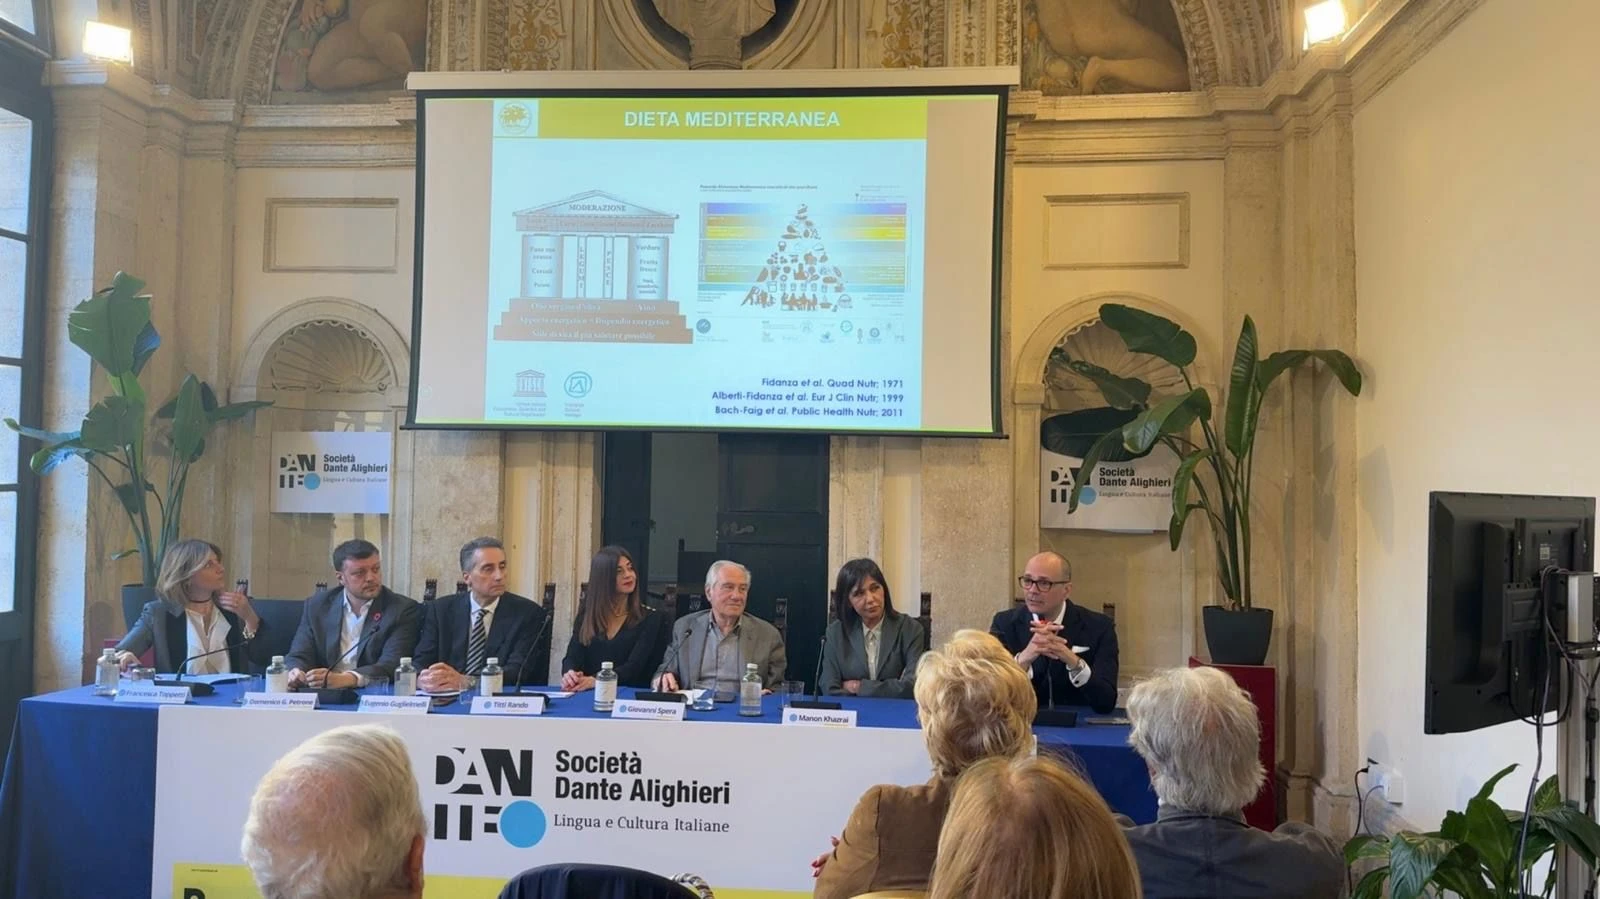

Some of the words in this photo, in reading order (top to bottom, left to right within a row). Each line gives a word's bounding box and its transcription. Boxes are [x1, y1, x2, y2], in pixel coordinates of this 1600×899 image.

[624, 111, 680, 127] DIETA
[685, 111, 841, 127] MEDITERRANEA
[568, 204, 626, 212] MODERAZIONE
[762, 378, 798, 387] Fidanza
[801, 379, 810, 387] et
[813, 379, 824, 387] al.
[827, 379, 854, 388] Quad
[882, 380, 904, 388] 1971
[712, 392, 783, 401] Alberti-Fidanza
[785, 393, 795, 401] et
[797, 393, 808, 401] al.
[811, 393, 826, 401] Eur
[828, 393, 833, 402] J
[836, 393, 854, 402] Clin
[882, 394, 904, 403] 1999
[715, 406, 763, 416] Bach-Faig
[765, 407, 775, 415] et
[777, 407, 788, 415] al.
[792, 407, 820, 416] Public
[823, 407, 853, 416] Health
[881, 408, 903, 417] 2011
[323, 454, 355, 463] Società
[323, 464, 348, 472] Dante
[350, 464, 388, 474] Alighieri
[1099, 467, 1135, 477] Società
[1099, 478, 1127, 487] Dante
[1130, 478, 1171, 488] Alighieri
[627, 705, 657, 713] Giovanni
[657, 707, 677, 715] Spera
[799, 714, 823, 722] Manon
[555, 749, 642, 775] Società
[555, 776, 622, 801] Dante
[630, 778, 731, 808] Alighieri
[553, 813, 601, 829] Lingua
[605, 819, 613, 828] e
[617, 816, 669, 831] Cultura
[674, 817, 730, 833] Italiane
